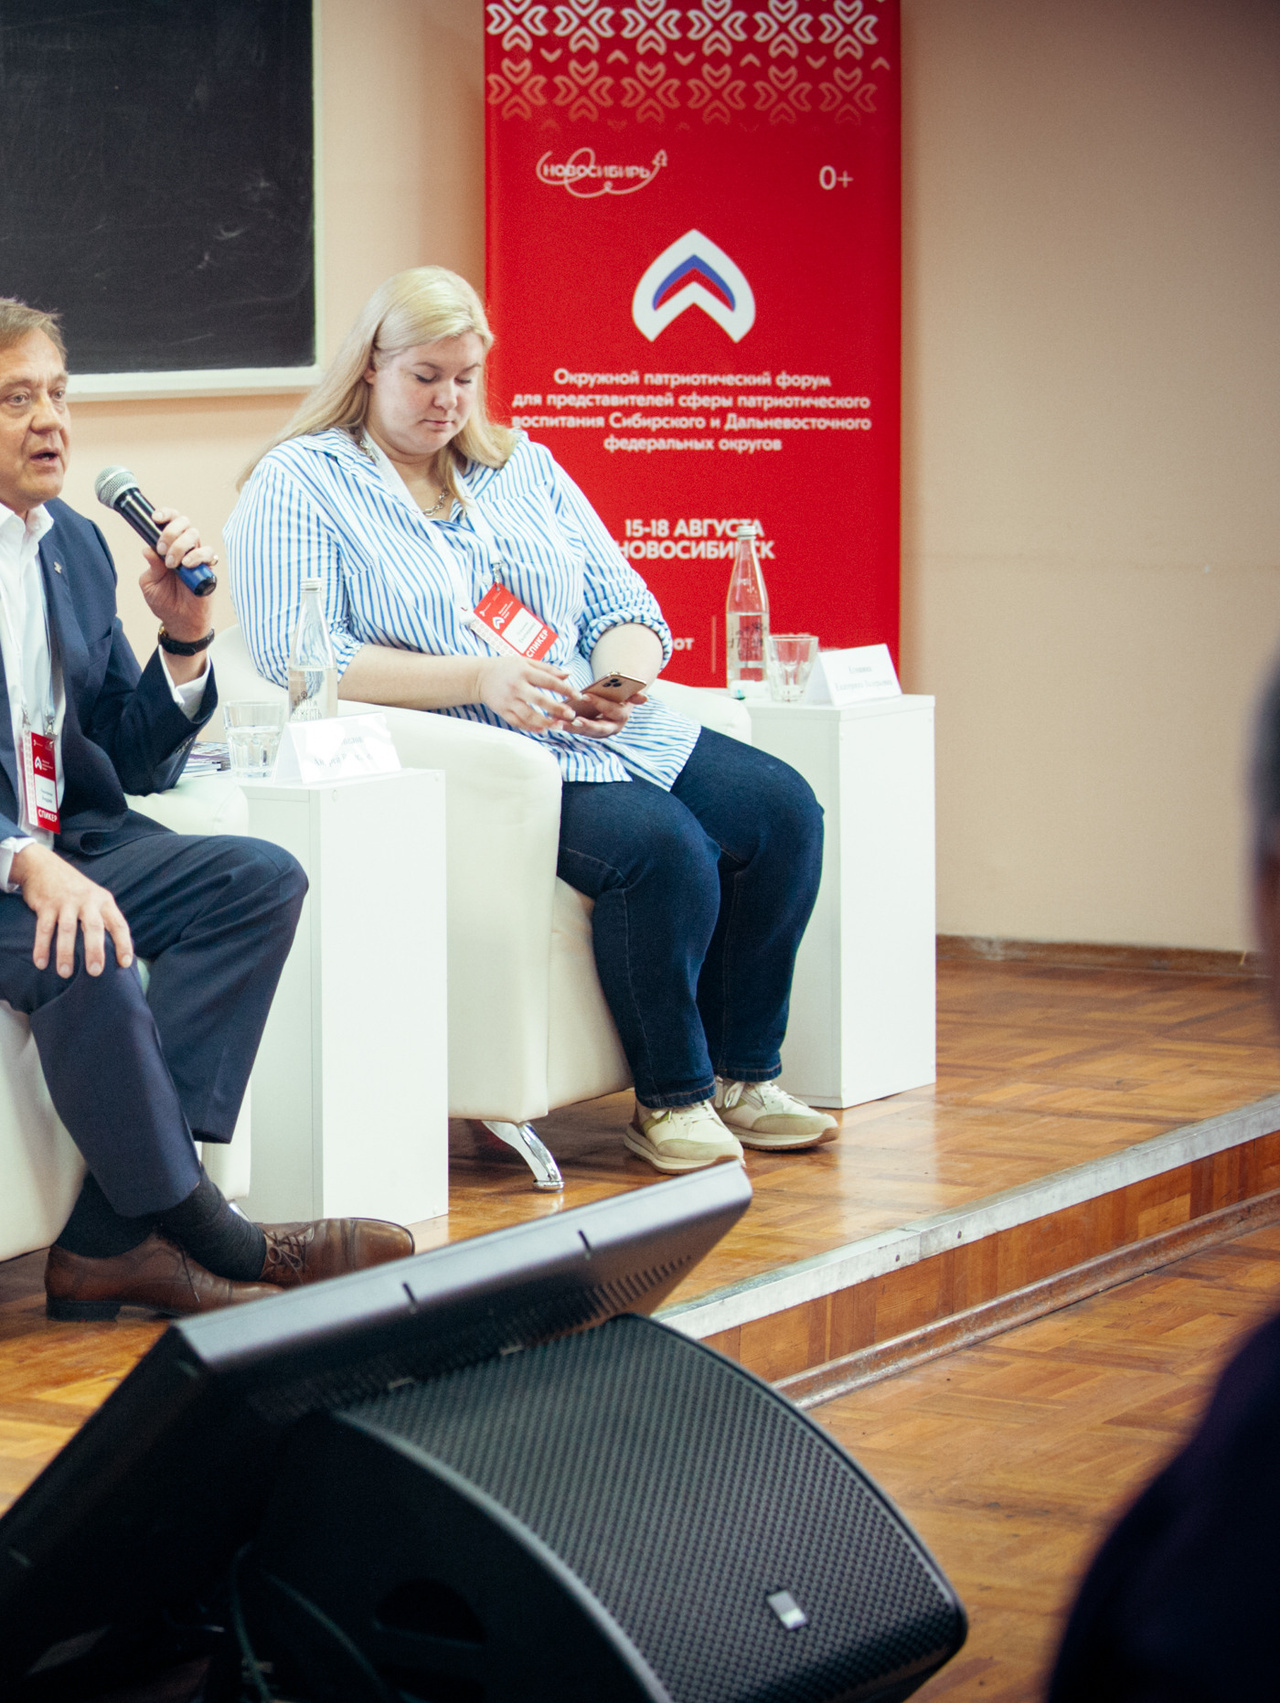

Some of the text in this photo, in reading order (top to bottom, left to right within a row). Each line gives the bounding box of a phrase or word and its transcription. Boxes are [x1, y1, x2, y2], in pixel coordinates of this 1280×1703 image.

[819, 165, 854, 190] 0+
[553, 368, 831, 390] Окружной патриотический форум
[511, 391, 871, 411] для представителей сферы патриотического
[512, 412, 872, 431] воспитания Сибирского и Дальневосточного
[603, 434, 782, 454] федеральных округов
[625, 518, 669, 537] 15-18
[526, 629, 548, 658] СПИКЕР
[38, 809, 58, 823] СПИКЕР
